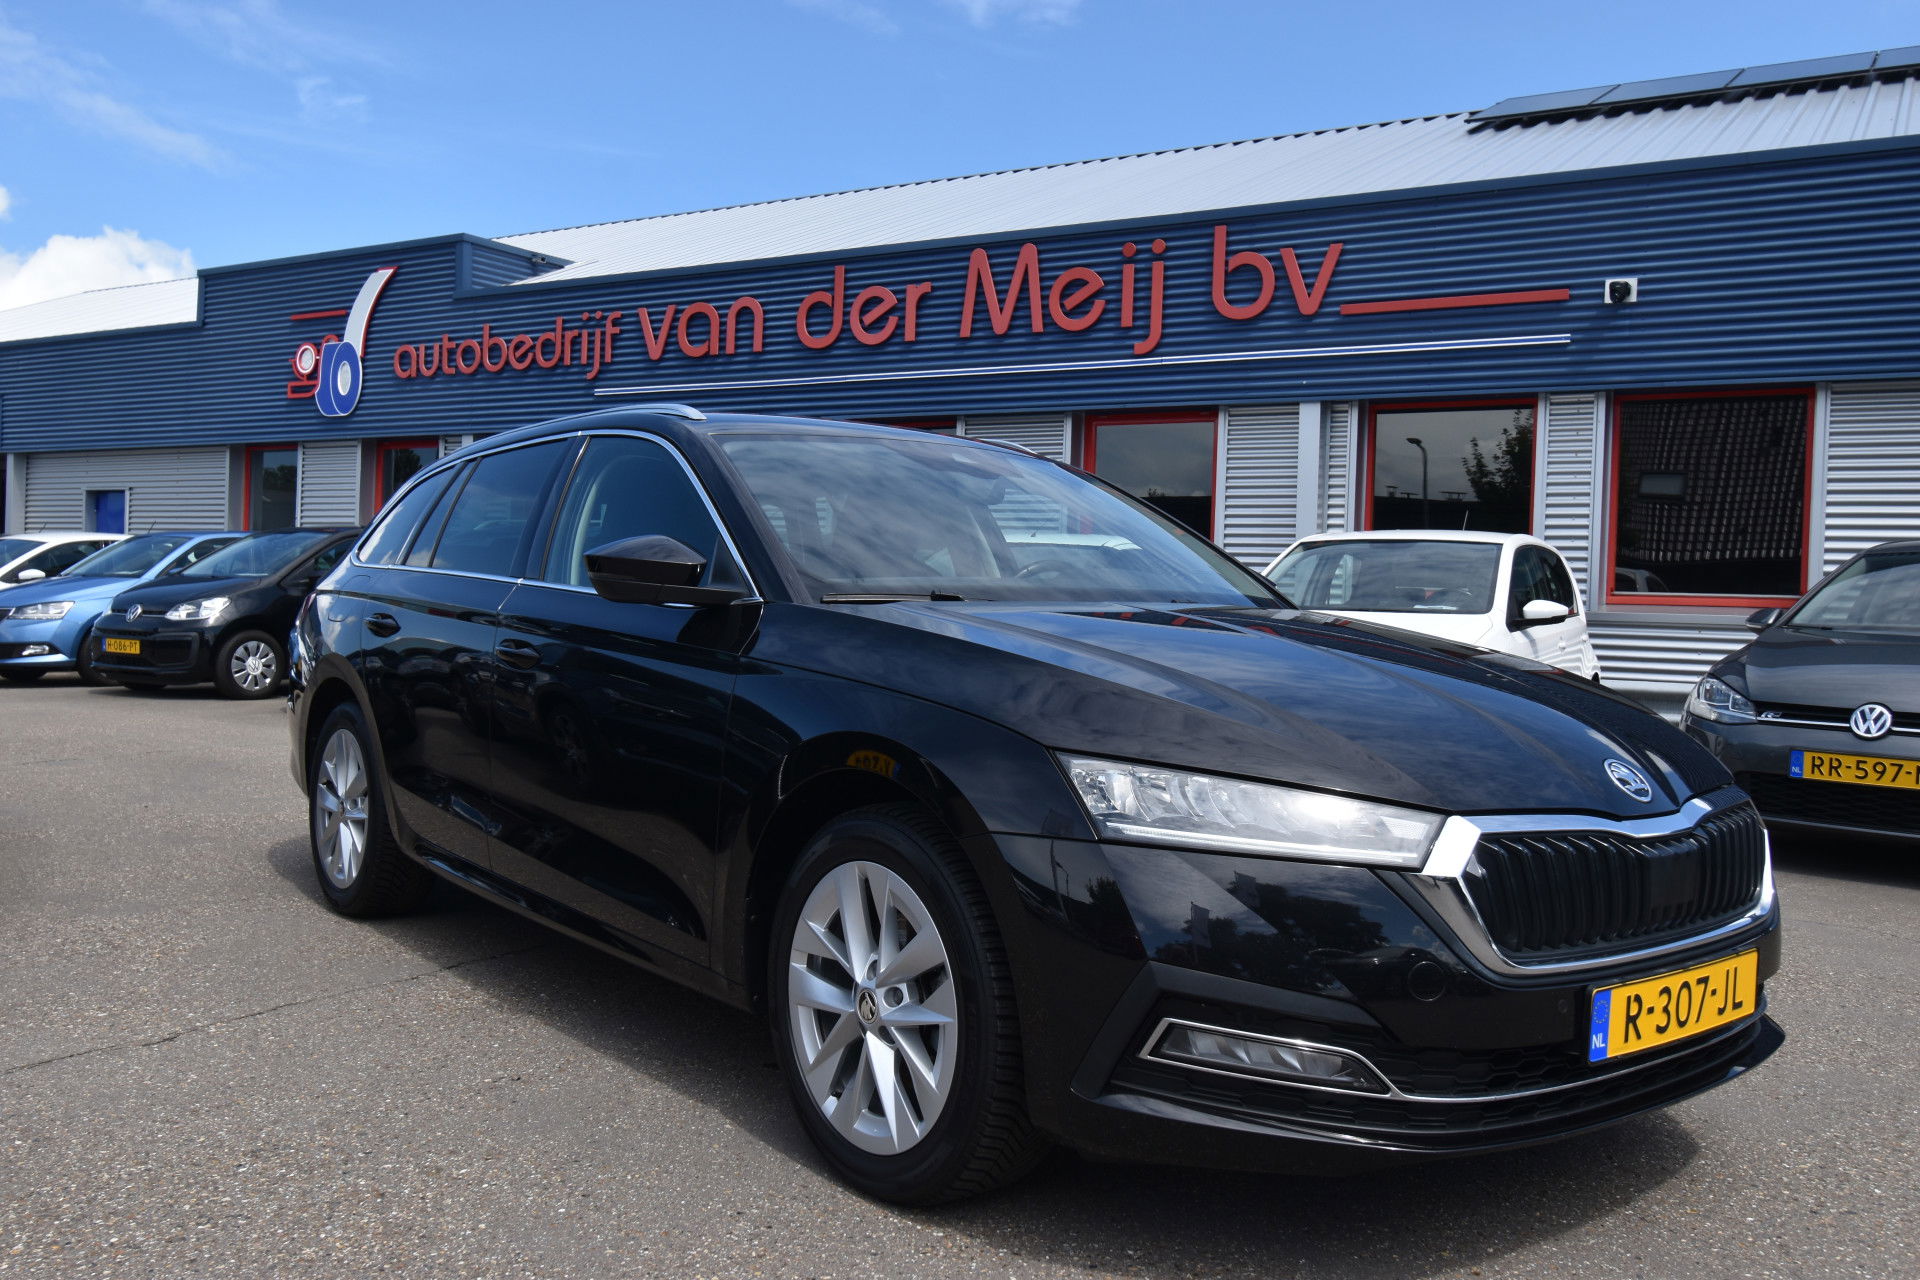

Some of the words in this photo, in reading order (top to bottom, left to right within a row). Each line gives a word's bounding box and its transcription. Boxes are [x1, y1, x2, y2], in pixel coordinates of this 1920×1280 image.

[393, 310, 622, 380] autobedrijf
[638, 297, 764, 361] van
[796, 265, 932, 349] der
[959, 239, 1164, 355] Meij
[1211, 224, 1344, 320] bv
[1791, 766, 1802, 774] NL
[1591, 1032, 1606, 1049] NL
[1624, 966, 1744, 1044] R-307-JL
